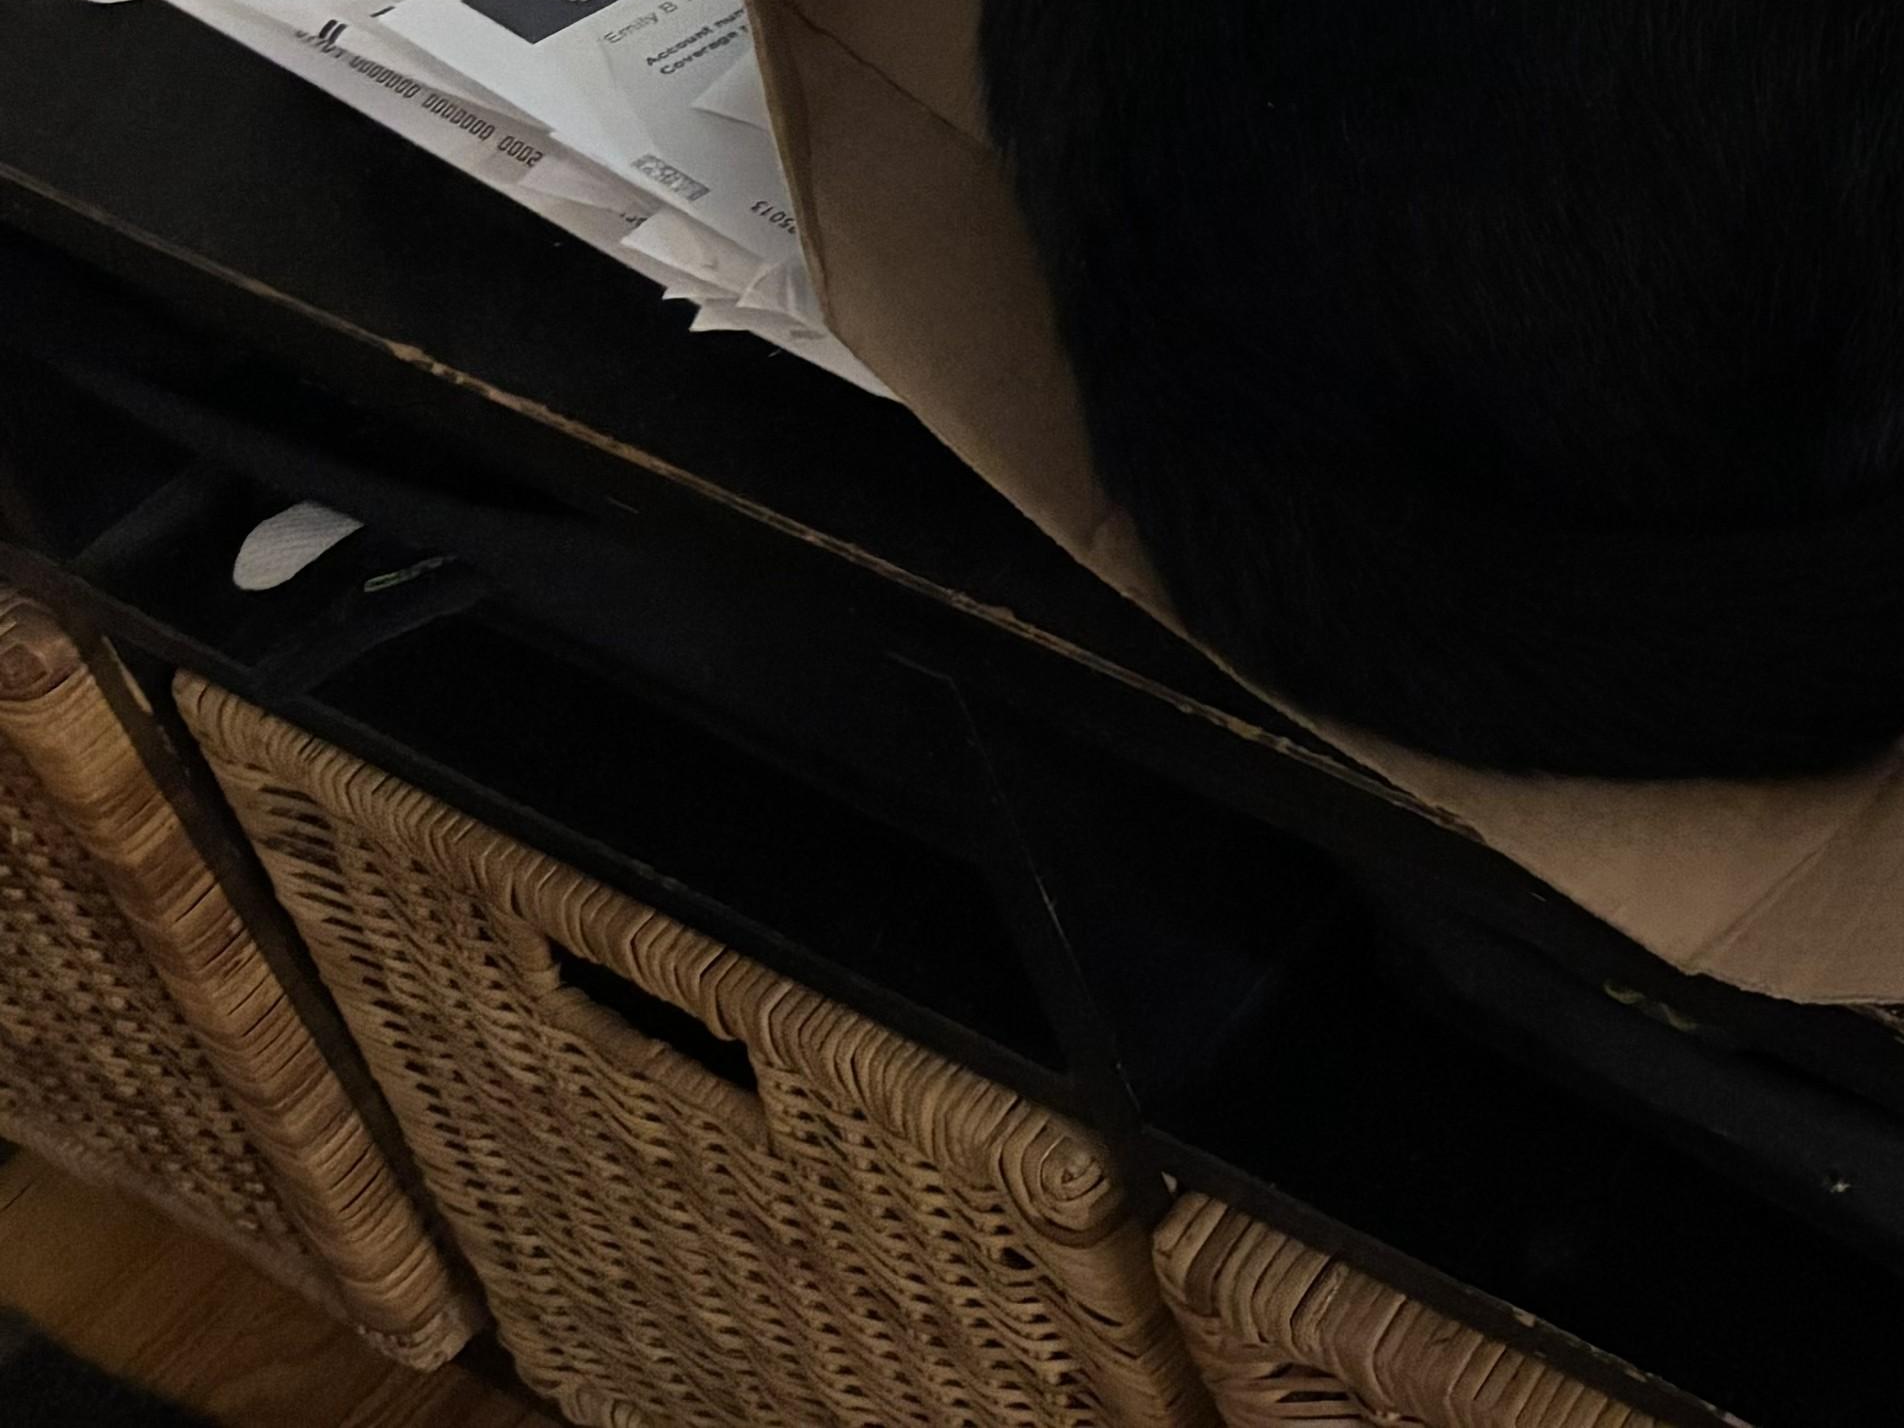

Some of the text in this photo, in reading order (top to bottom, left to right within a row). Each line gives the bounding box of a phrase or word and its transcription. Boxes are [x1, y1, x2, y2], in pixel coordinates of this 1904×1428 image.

[603, 11, 660, 44] Emily
[658, 0, 678, 15] B
[646, 26, 712, 66] Account
[660, 30, 739, 75] Coverage
